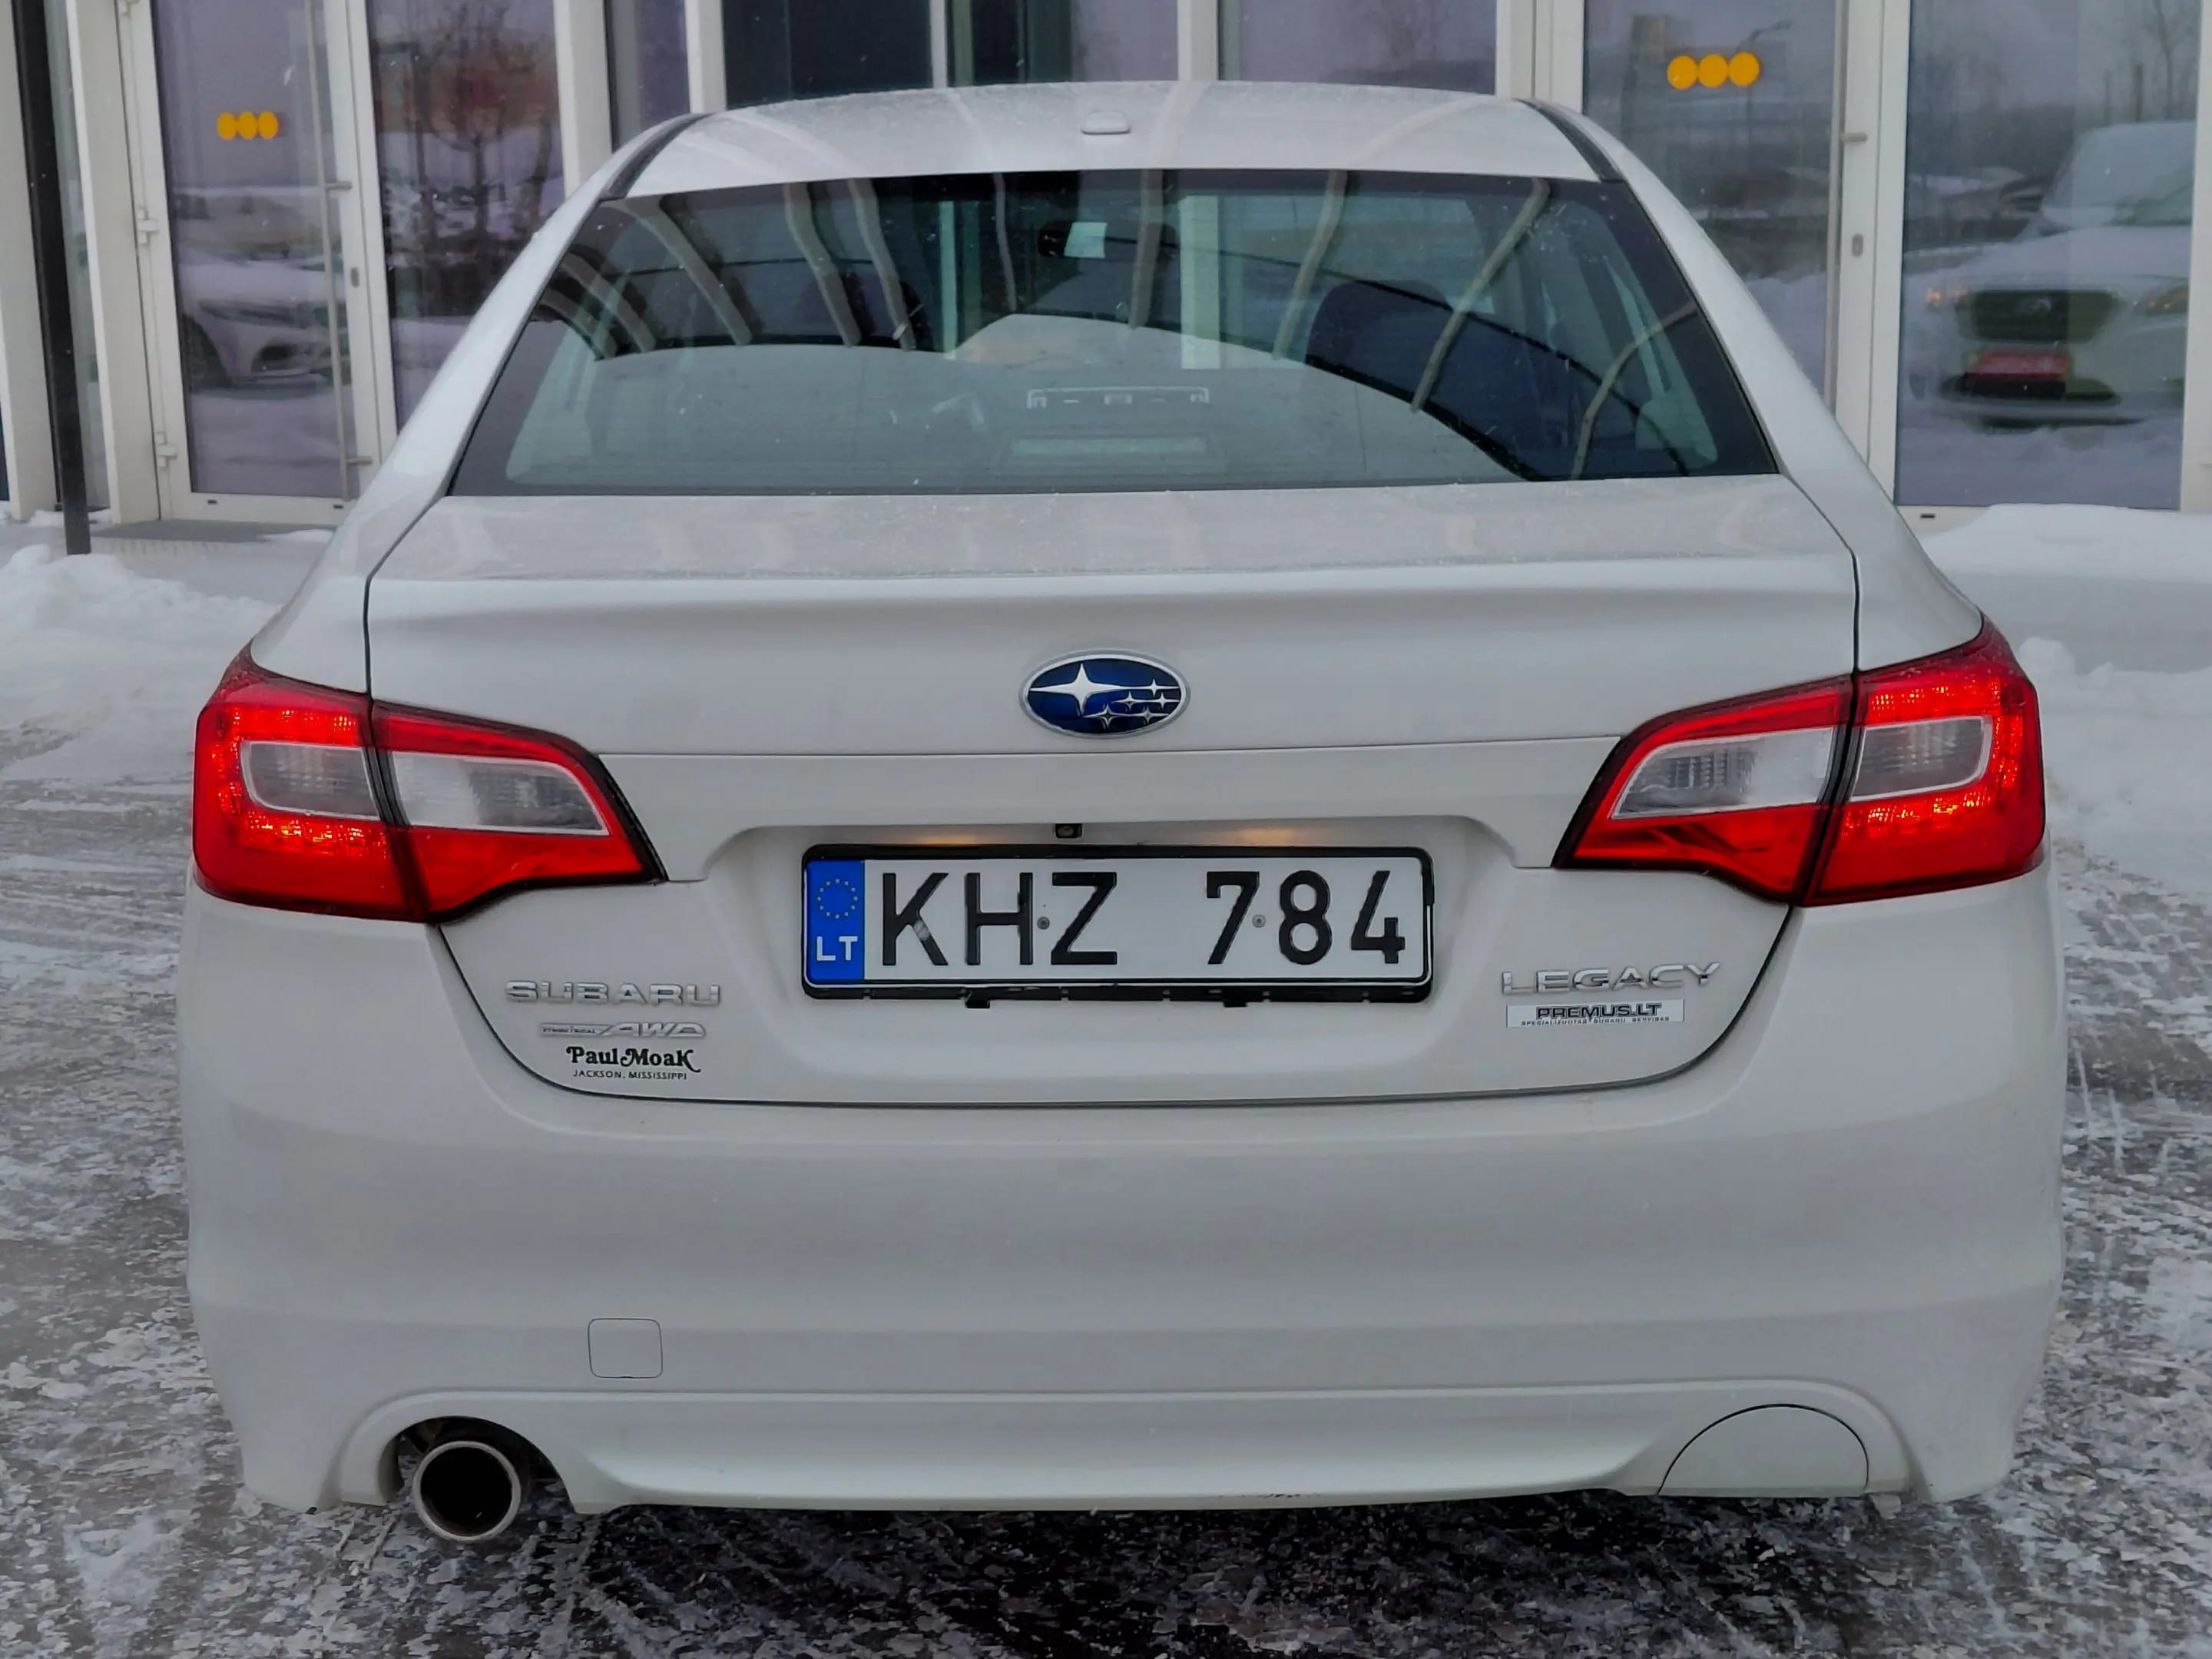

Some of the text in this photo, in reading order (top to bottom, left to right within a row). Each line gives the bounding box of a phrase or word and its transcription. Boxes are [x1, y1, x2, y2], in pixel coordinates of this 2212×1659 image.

[881, 869, 1406, 966] KHZ 784
[816, 935, 859, 962] LT
[1502, 961, 1720, 995] LEGACY
[505, 980, 720, 1006] SUBARU
[1535, 1002, 1663, 1021] PREMUS.LT
[601, 1022, 707, 1038] AWD
[565, 1045, 620, 1065] Paul
[628, 1071, 687, 1080] MISSISSIPPI
